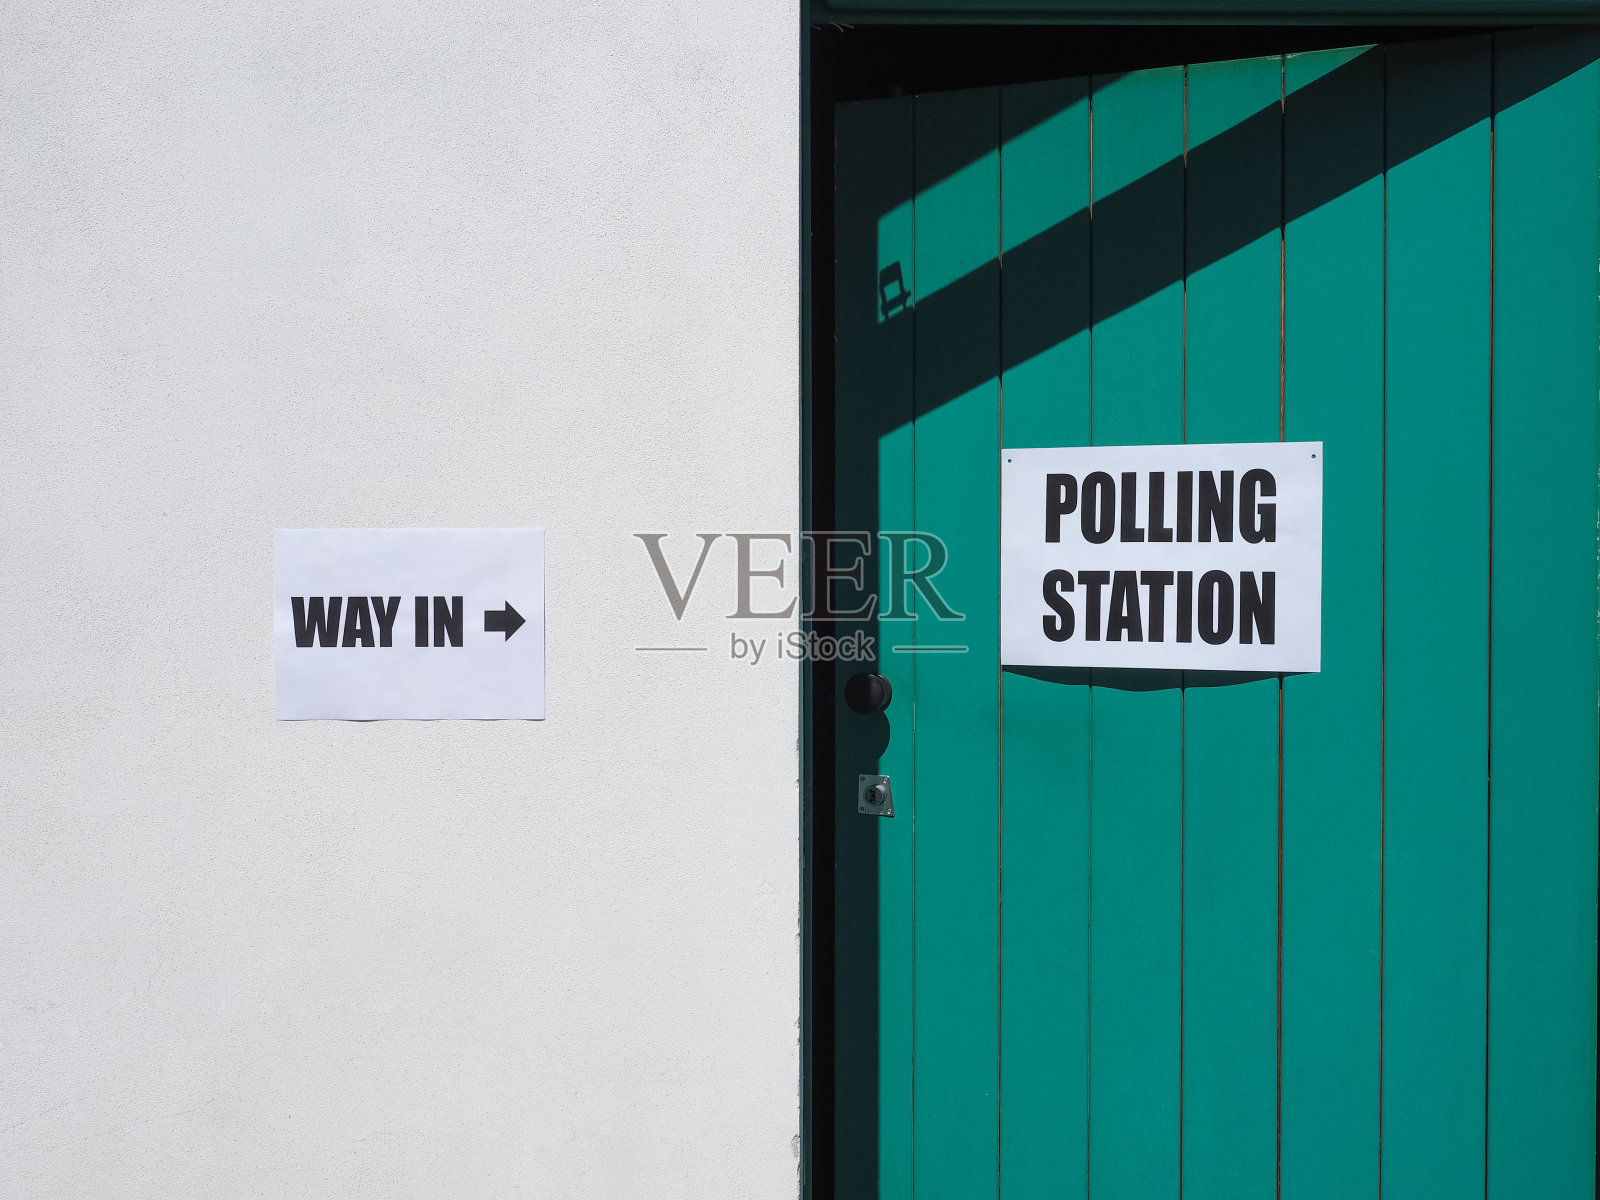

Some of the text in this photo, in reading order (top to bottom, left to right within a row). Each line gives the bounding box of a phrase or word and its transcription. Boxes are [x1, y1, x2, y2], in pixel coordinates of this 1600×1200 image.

[1045, 468, 1277, 545] POLLING
[290, 596, 464, 648] WAY IN
[1042, 568, 1276, 645] STATION
